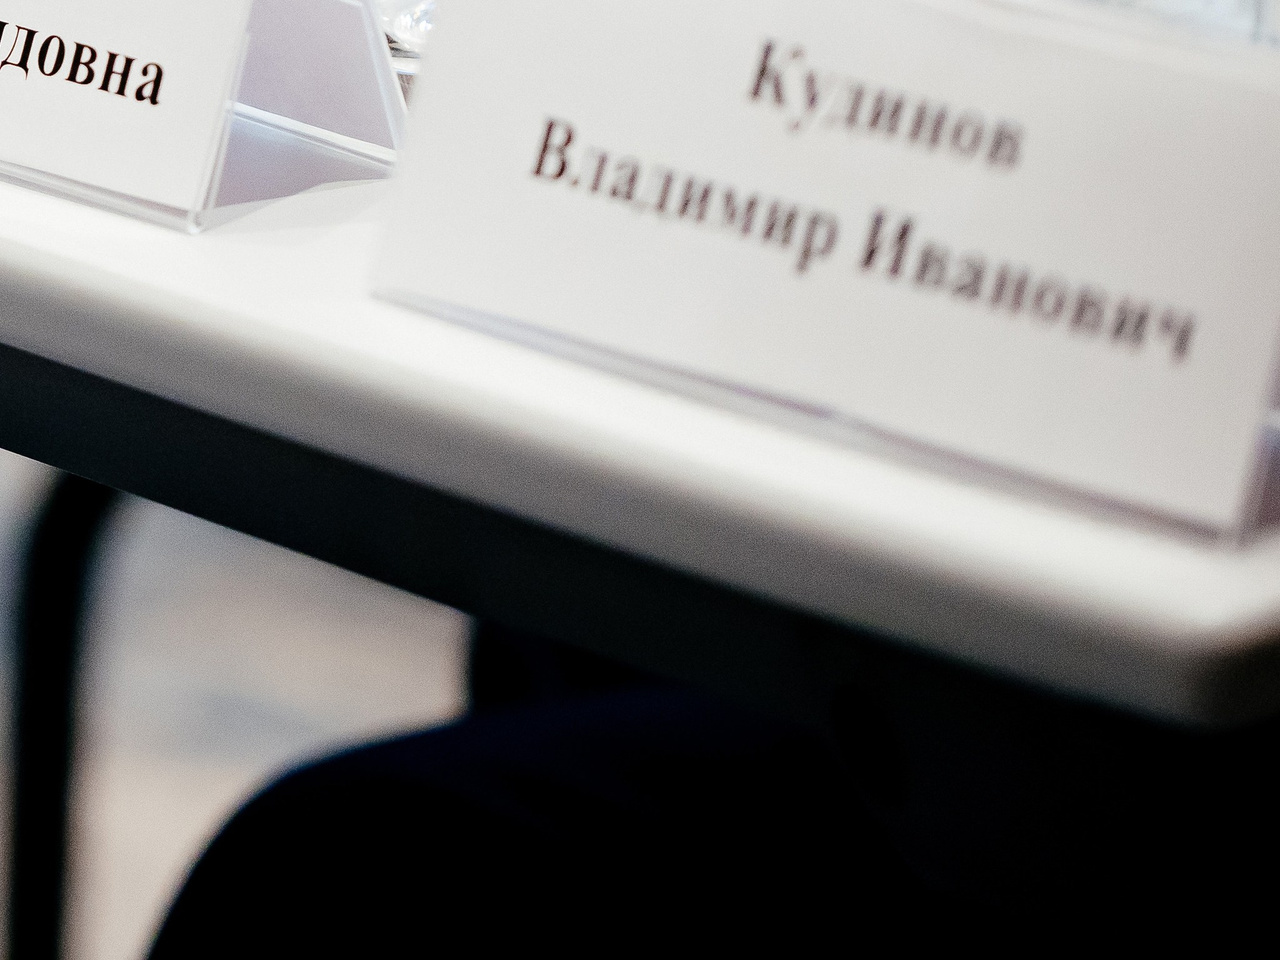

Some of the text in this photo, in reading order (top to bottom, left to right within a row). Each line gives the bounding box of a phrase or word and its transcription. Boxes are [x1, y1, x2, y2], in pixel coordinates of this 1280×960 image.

[747, 38, 1025, 169] Кудинов
[530, 115, 1197, 365] Владимир Иванович
